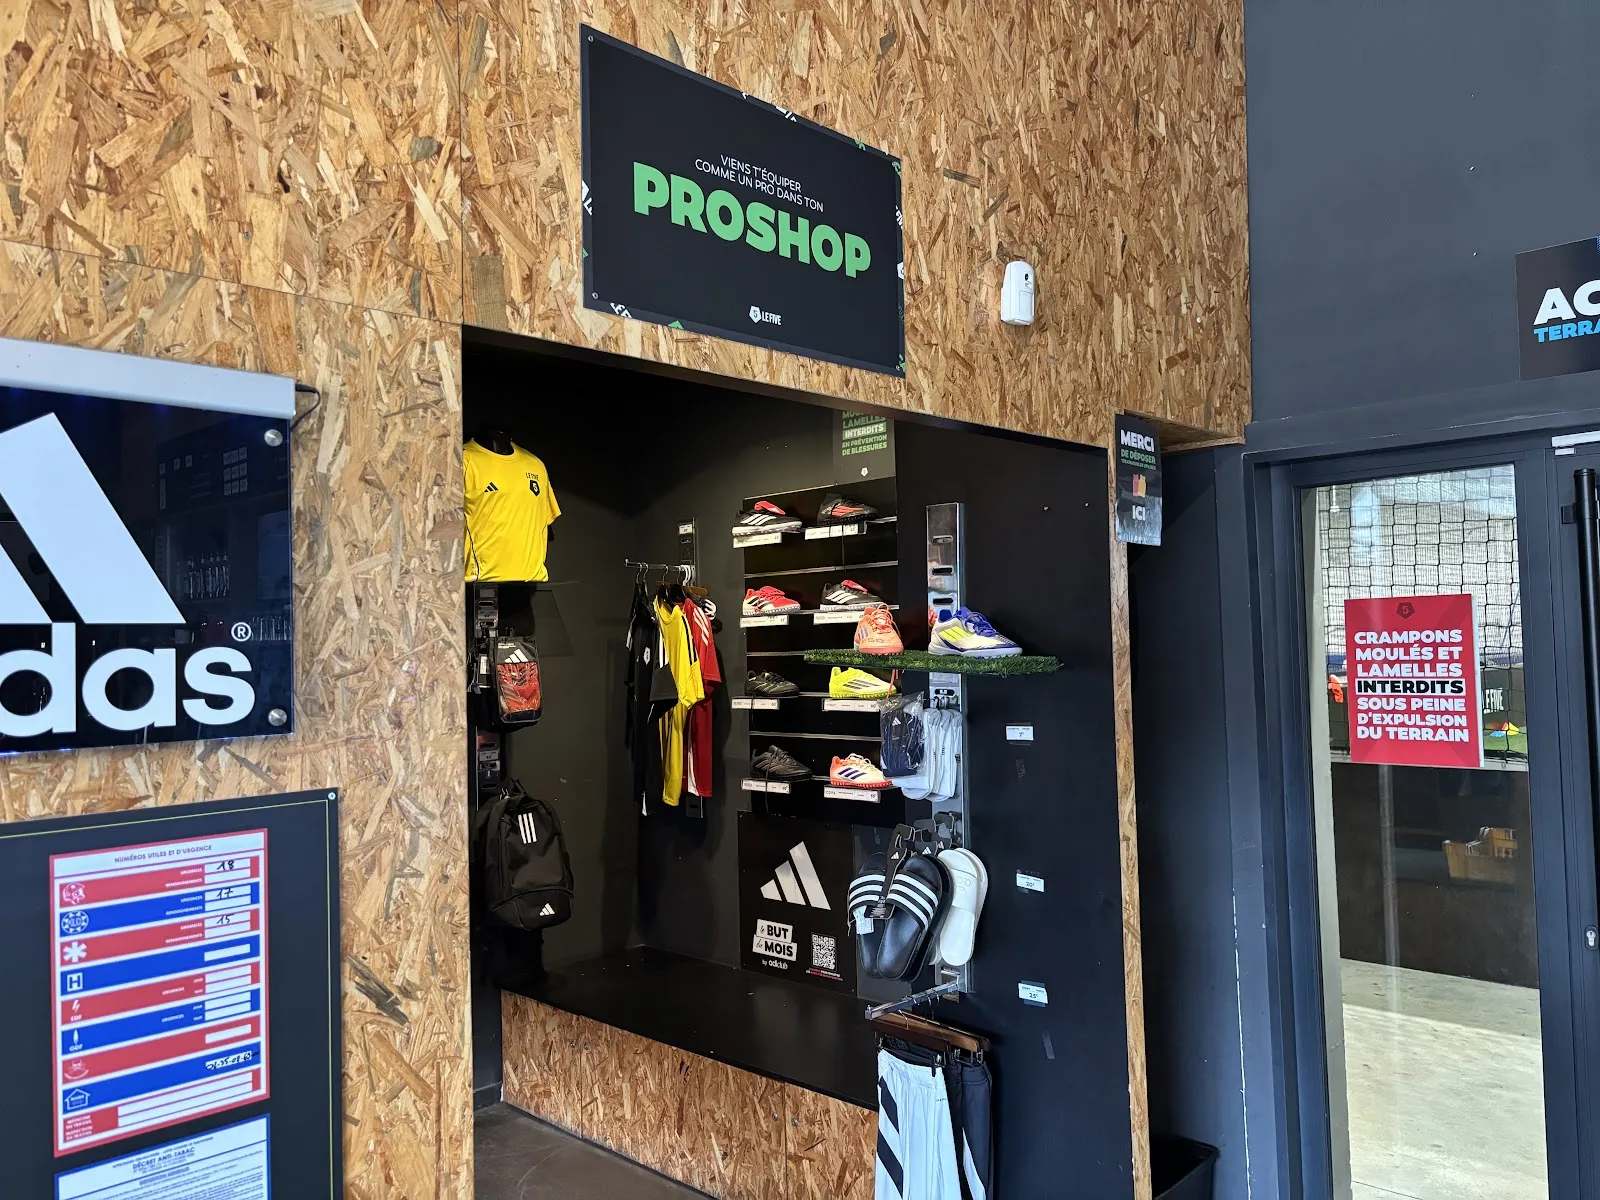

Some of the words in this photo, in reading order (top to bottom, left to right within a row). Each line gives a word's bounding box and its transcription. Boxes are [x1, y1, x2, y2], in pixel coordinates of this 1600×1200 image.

[720, 154, 751, 175] VIENS
[753, 164, 802, 193] T'ÉQUIPER
[695, 158, 736, 183] COMME
[738, 171, 754, 188] UN
[755, 178, 775, 196] PRO
[777, 185, 803, 206] DANS
[804, 195, 824, 212] TON
[633, 161, 872, 279] PROSHOP
[845, 423, 884, 439] INTERDITS
[842, 441, 850, 449] EN
[850, 434, 888, 447] PRÉVENTION
[842, 448, 851, 456] DE
[851, 441, 888, 455] BLESSURES
[1120, 429, 1155, 453] MERCI
[1120, 448, 1129, 458] DE
[1130, 450, 1156, 465] DÉPOSER
[1132, 505, 1146, 521] ICI
[1354, 629, 1462, 645] CRAMPONS
[1355, 644, 1434, 661] MOULÉS
[1438, 647, 1462, 660] ET
[1357, 663, 1462, 677] LAMELLES
[1357, 680, 1464, 694] INTERDITS
[1357, 697, 1407, 711] SOUS
[1411, 698, 1466, 711] PEINE
[1357, 711, 1467, 727] D'EXPULSION
[1357, 726, 1382, 740] DU
[1386, 727, 1469, 742] TERRAIN
[114, 853, 146, 863] NUMÉROS
[147, 850, 167, 859] UTILES
[176, 845, 212, 855] D'URGENCE
[216, 860, 235, 871] 18
[216, 887, 234, 899] 17
[216, 913, 235, 925] 15
[767, 924, 789, 940] BUT
[764, 940, 794, 957] MOIS
[132, 1158, 157, 1170] DÉCRET
